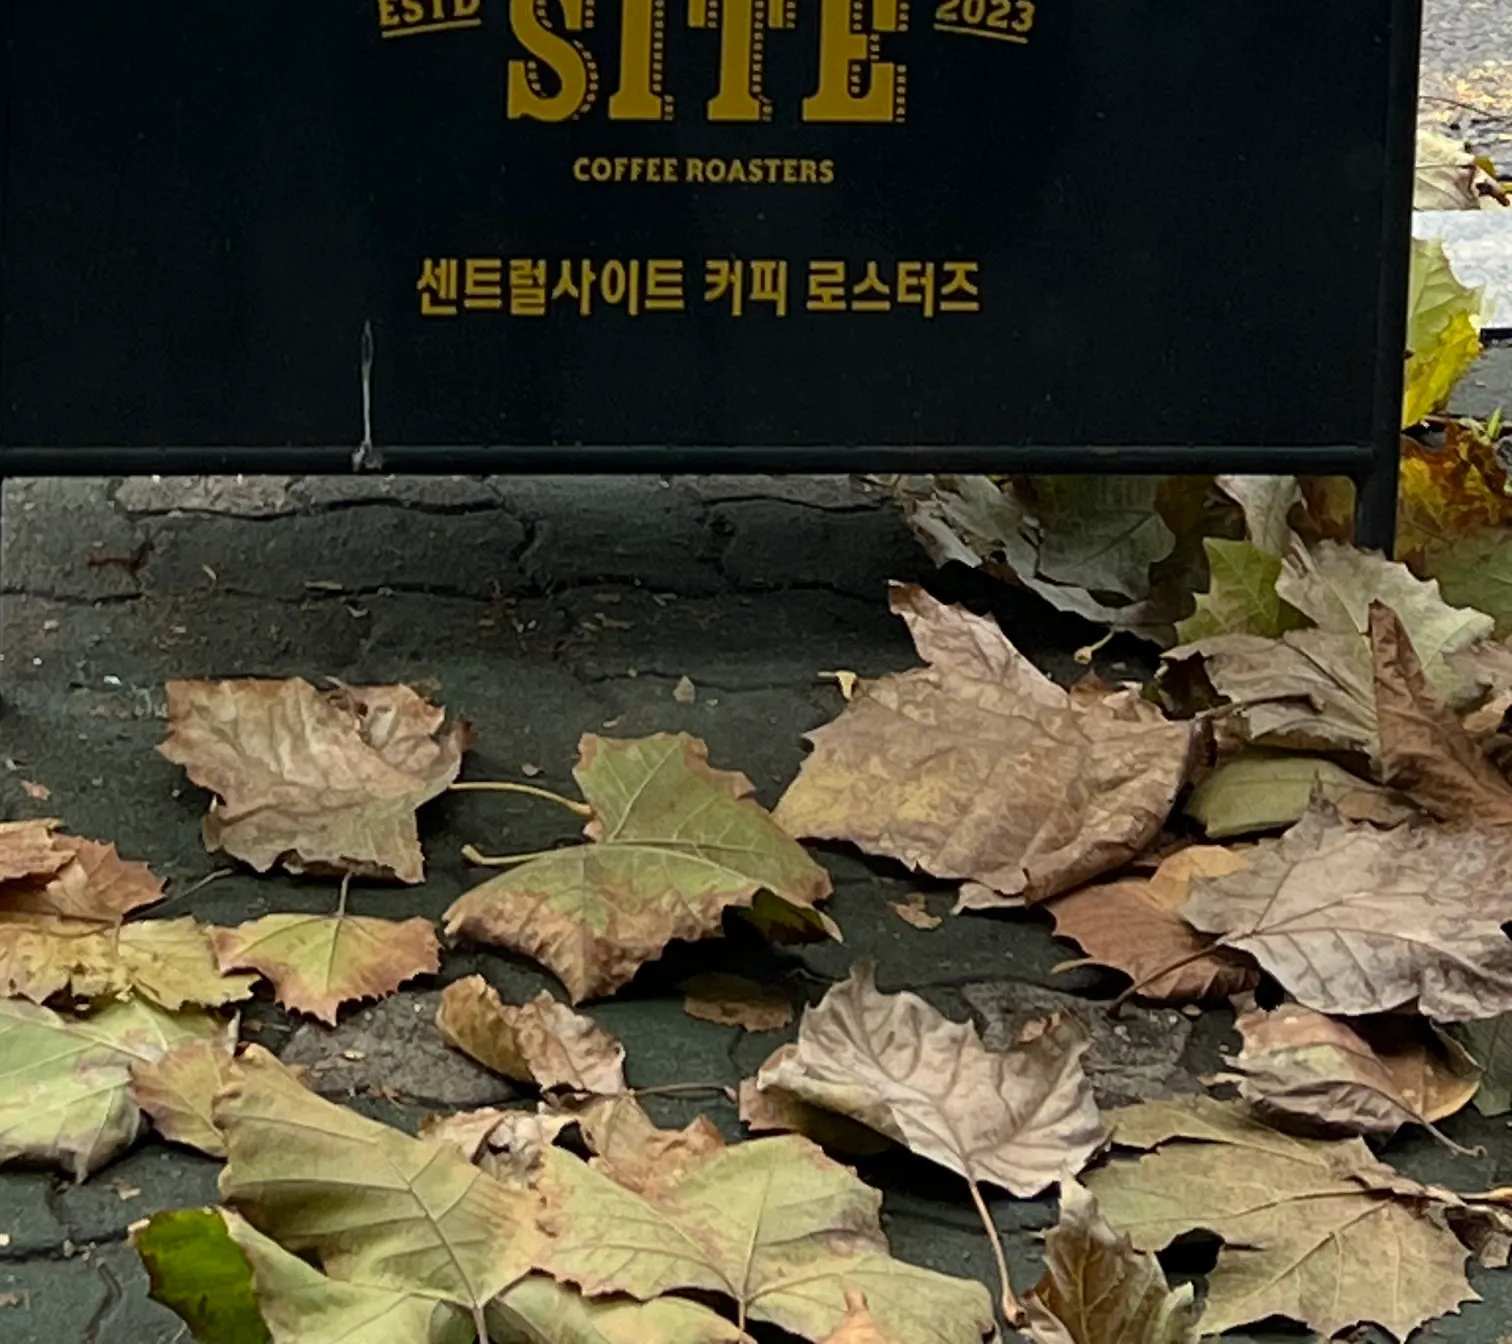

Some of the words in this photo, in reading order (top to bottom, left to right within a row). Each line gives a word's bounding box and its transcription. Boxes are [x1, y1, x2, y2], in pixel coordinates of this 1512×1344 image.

[572, 157, 678, 182] COFFEE
[685, 158, 835, 184] ROASTERS
[416, 257, 685, 317] 센트럴사이트
[704, 258, 788, 317] 커피
[806, 259, 982, 318] 로스터즈
